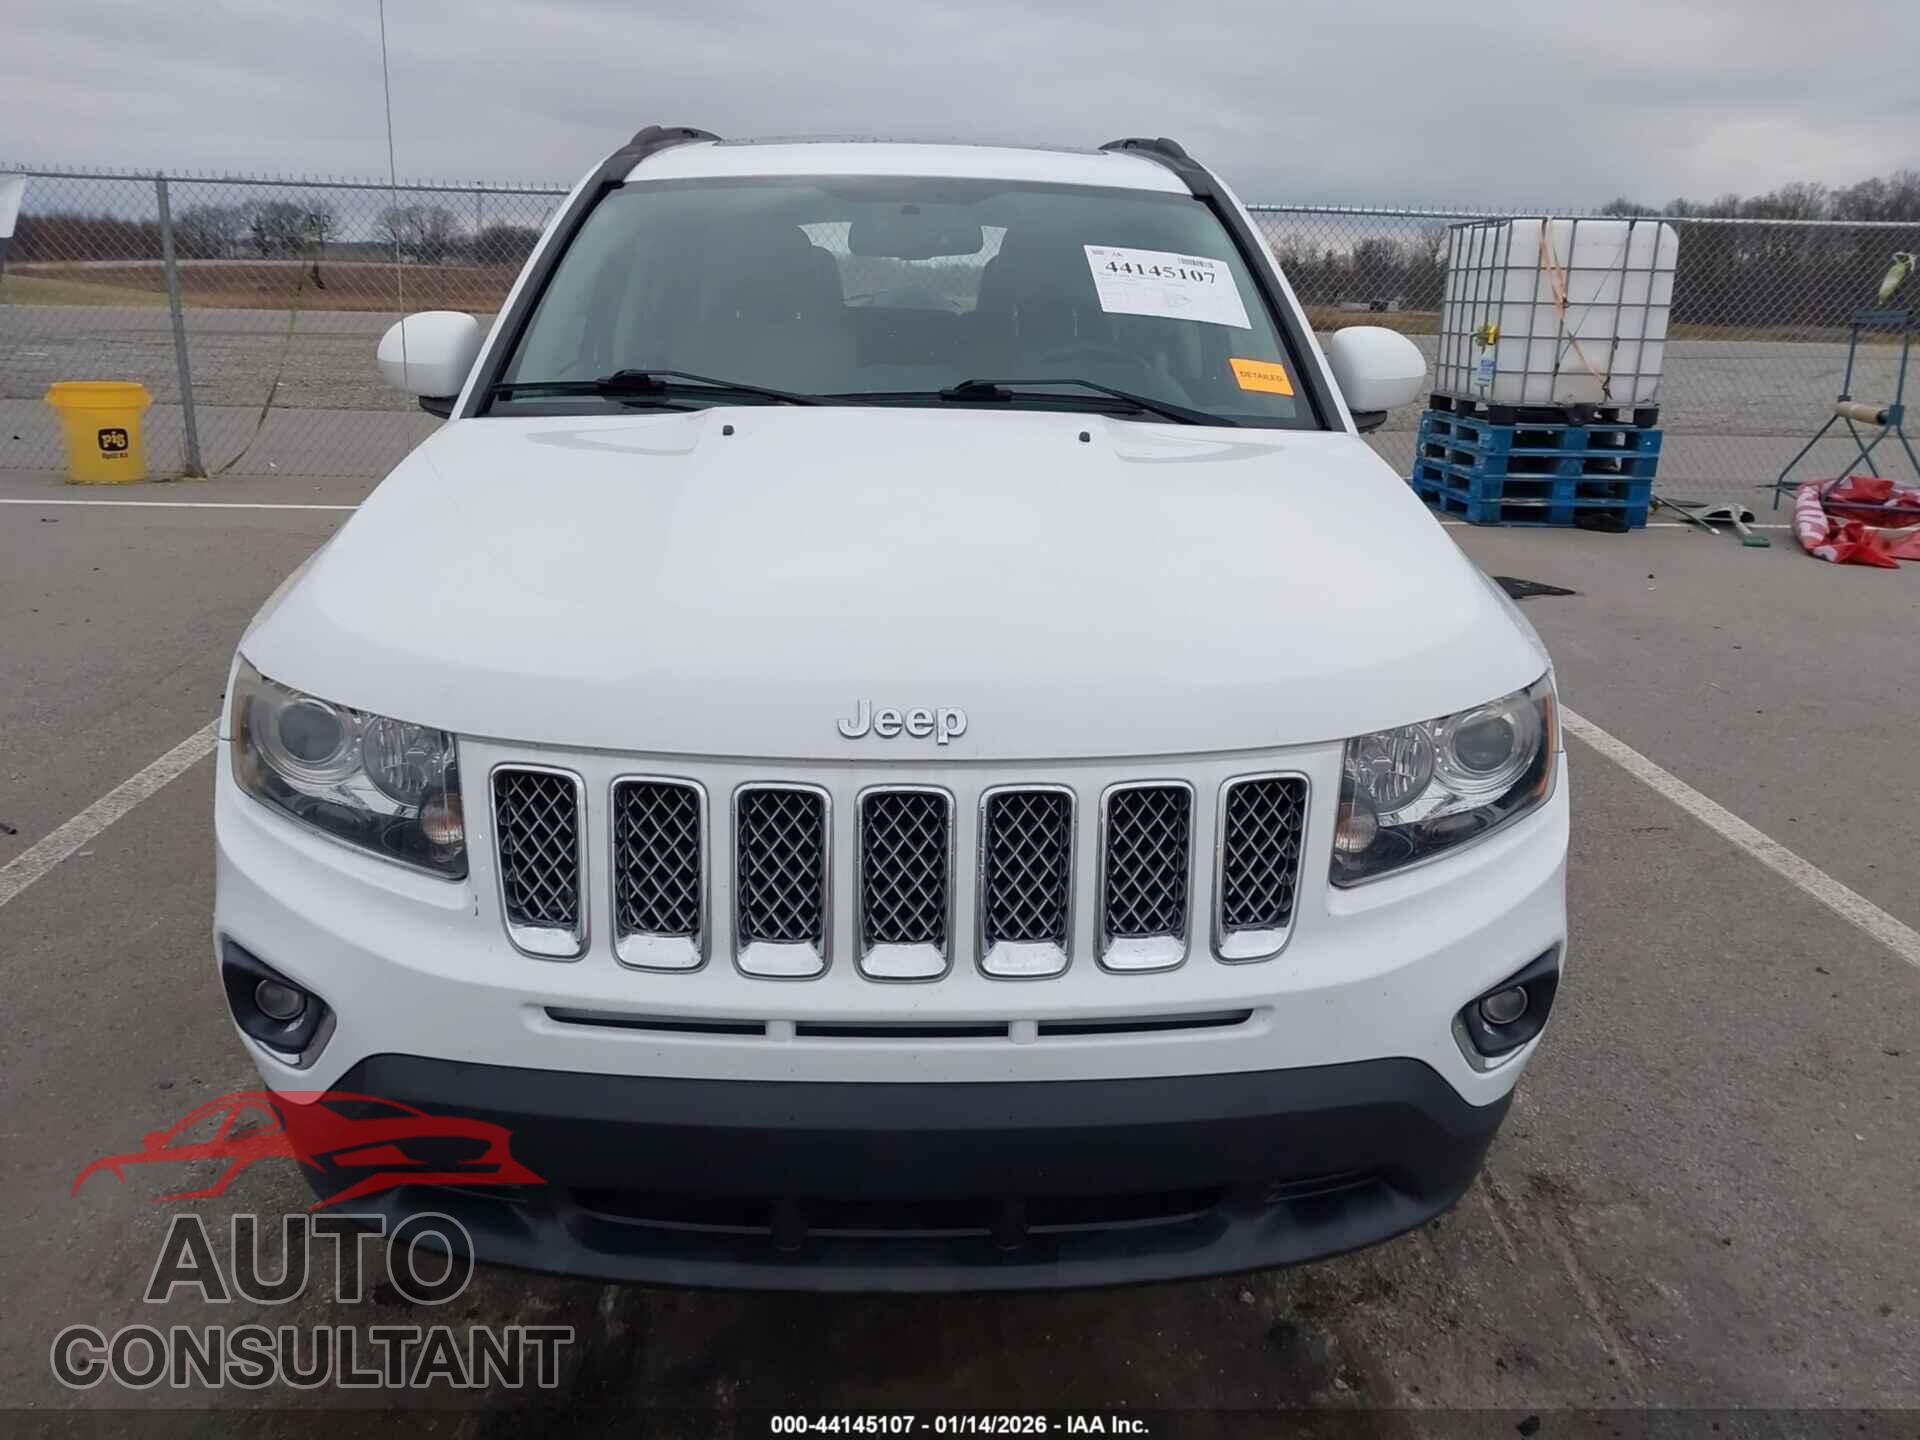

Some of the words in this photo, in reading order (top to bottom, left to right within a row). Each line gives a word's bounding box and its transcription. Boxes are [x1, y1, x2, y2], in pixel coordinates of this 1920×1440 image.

[1105, 261, 1216, 284] 44145107
[1240, 370, 1283, 381] DETAILED
[837, 698, 968, 746] Jeep
